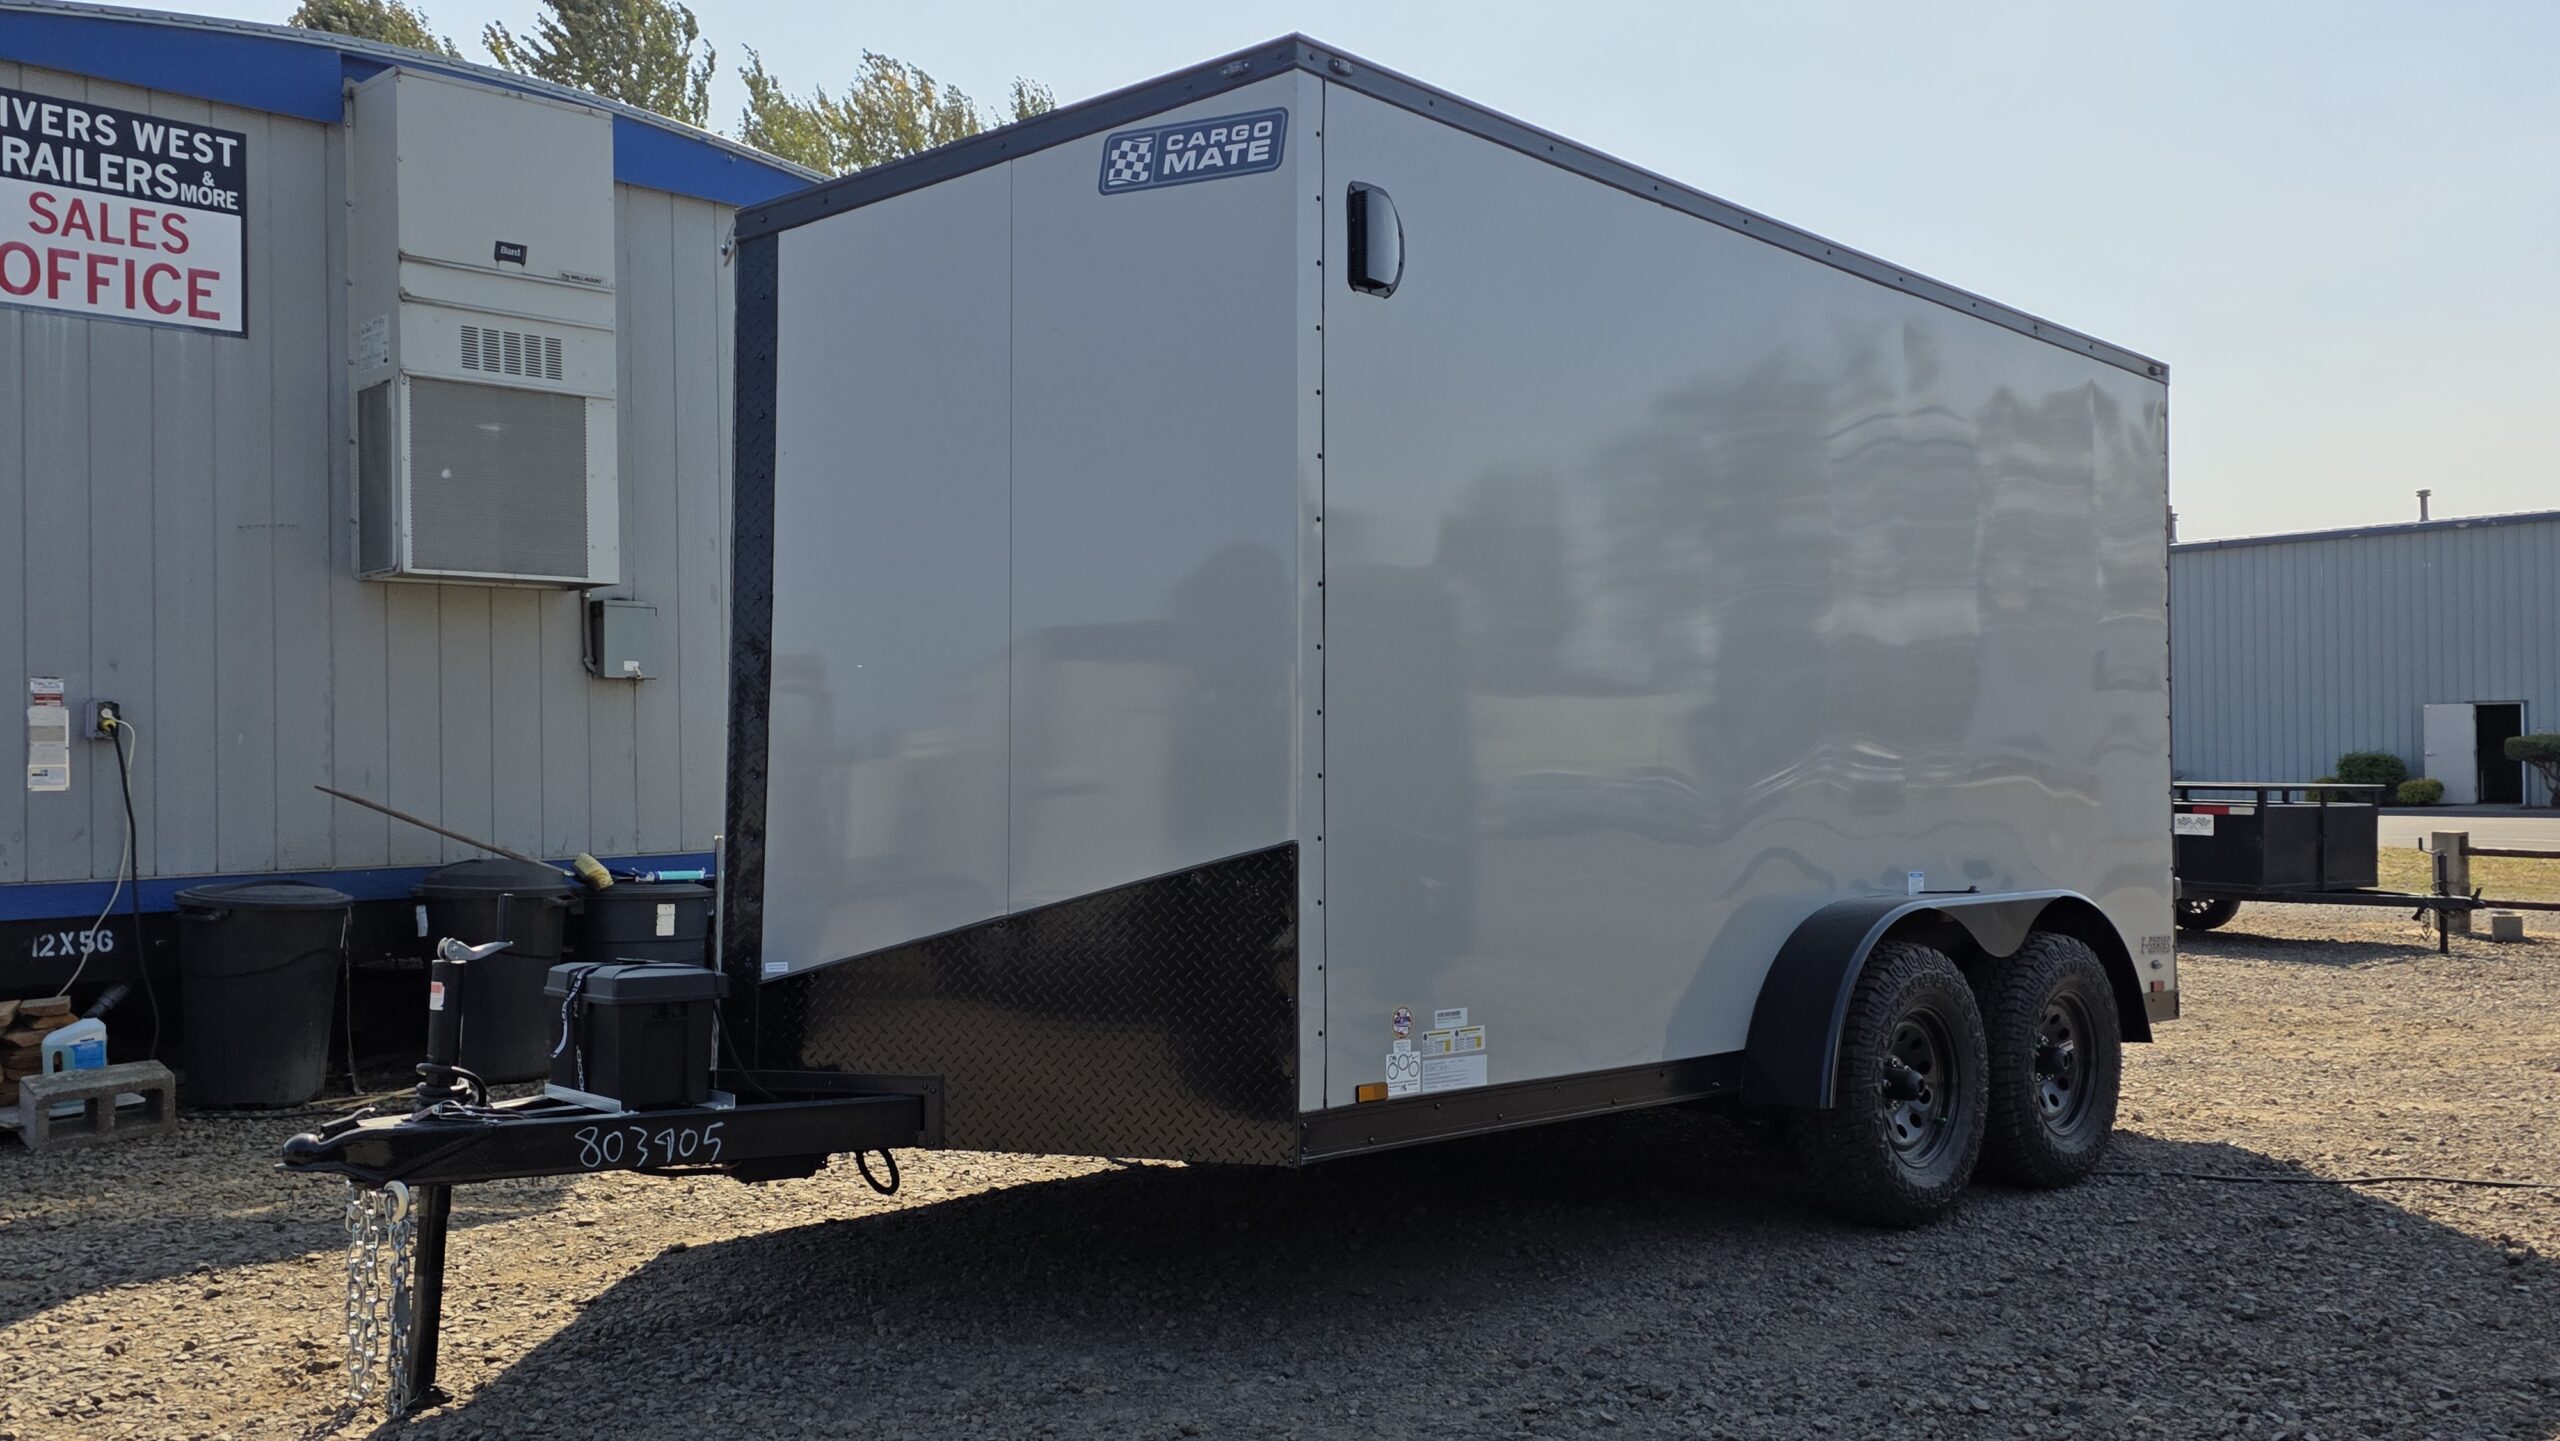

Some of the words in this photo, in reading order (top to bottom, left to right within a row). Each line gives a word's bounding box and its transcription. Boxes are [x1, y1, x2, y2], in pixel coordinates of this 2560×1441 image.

[0, 95, 117, 146] IVERS
[132, 120, 238, 168] WEST
[1166, 121, 1273, 151] CARGO
[2, 135, 179, 199] RAILERS
[1163, 138, 1271, 175] MATE
[180, 183, 239, 210] MORE
[201, 171, 215, 187] &
[28, 191, 190, 254] SALES
[500, 245, 521, 257] Bard
[0, 241, 221, 321] OFFICE
